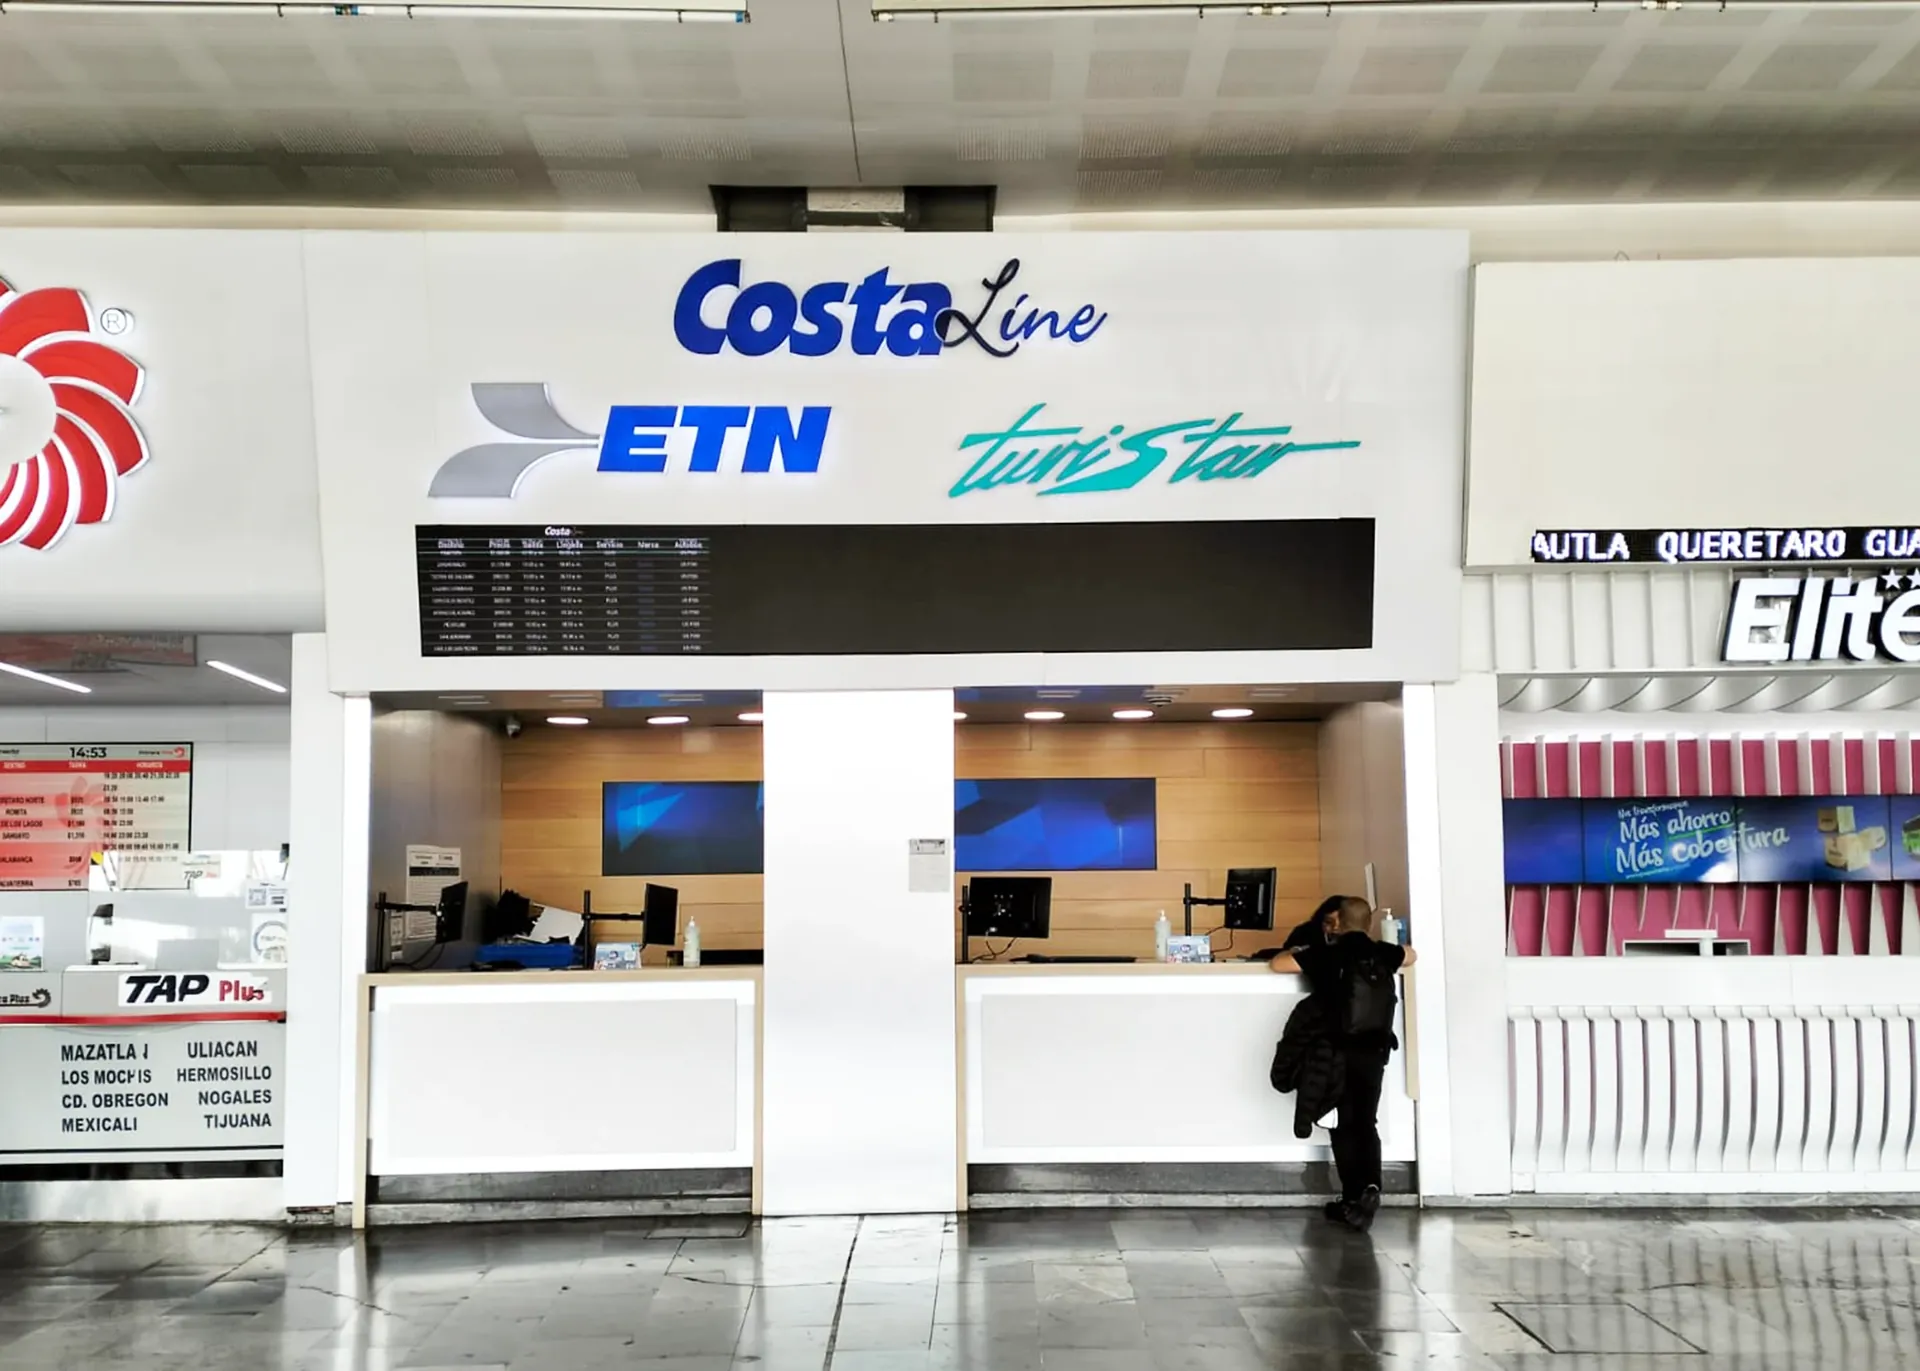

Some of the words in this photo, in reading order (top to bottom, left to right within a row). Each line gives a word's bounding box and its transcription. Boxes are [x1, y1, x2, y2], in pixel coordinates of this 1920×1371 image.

[674, 258, 952, 357] Costa
[935, 257, 1108, 358] Line
[597, 405, 832, 473] ETN
[545, 526, 570, 536] Costa
[1657, 530, 1846, 563] QUERETARO
[70, 747, 107, 758] 14:53
[1620, 816, 1660, 844] Más
[1667, 809, 1731, 835] ahorro
[1616, 842, 1665, 873] Más
[1671, 822, 1791, 863] cobertura
[125, 974, 210, 1004] TAP
[219, 979, 265, 1002] Plus
[61, 1070, 89, 1085] LOS
[176, 1065, 273, 1083] HERMOSILLO
[62, 1094, 87, 1108] CD.
[92, 1092, 169, 1108] OBREGON
[198, 1089, 273, 1106] NOGALES
[61, 1117, 138, 1132] MEXICALI
[204, 1113, 273, 1129] TIJUANA
